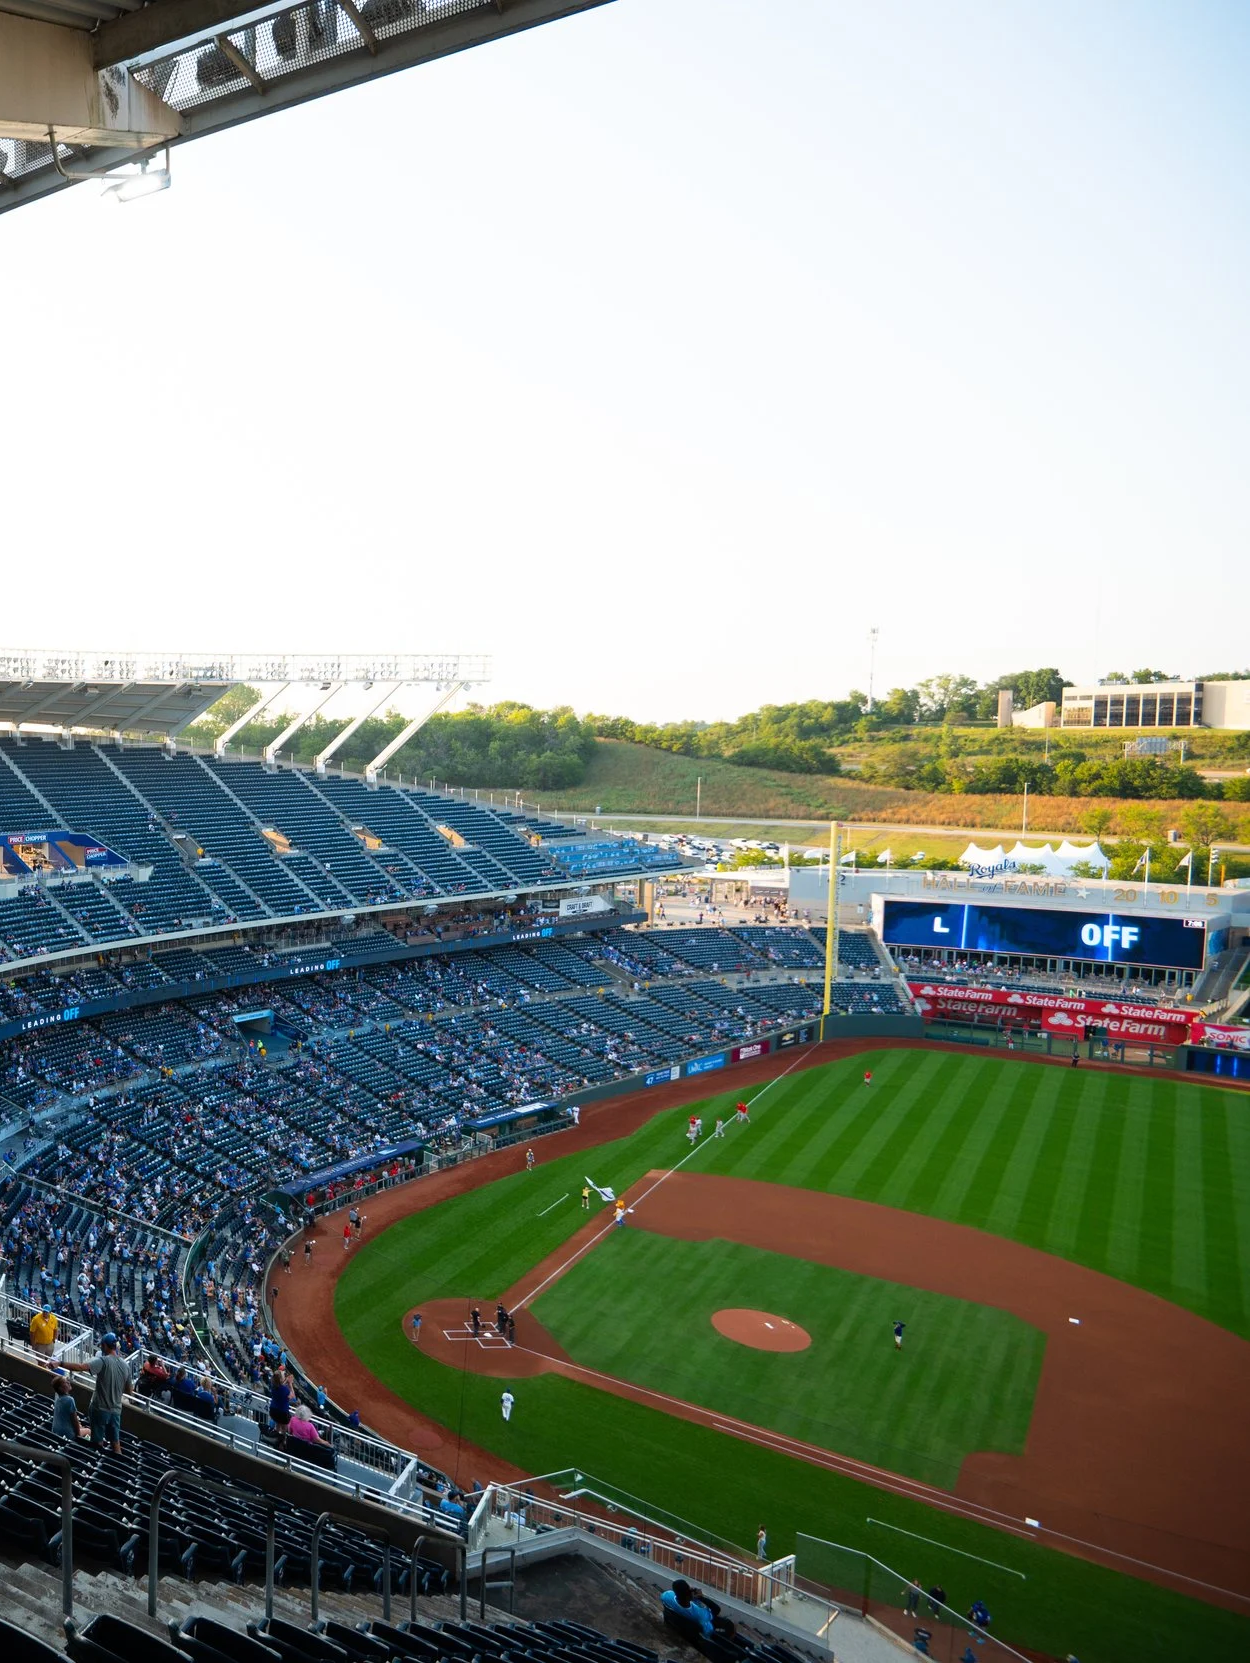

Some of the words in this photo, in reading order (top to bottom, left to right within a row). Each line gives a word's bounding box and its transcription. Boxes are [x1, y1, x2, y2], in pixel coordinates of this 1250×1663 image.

[968, 858, 1017, 880] Royals
[922, 874, 975, 893] HALL
[1003, 879, 1067, 897] FAME
[582, 901, 593, 909] DRAFT
[1113, 888, 1138, 903] 20
[1158, 890, 1180, 905] 10
[1204, 892, 1219, 907] 5
[933, 916, 950, 933] L
[513, 931, 540, 940] LEADING
[542, 928, 552, 937] OFF
[1081, 923, 1140, 949] OFF
[290, 963, 325, 975] LEADING
[326, 959, 340, 970] OFF
[22, 1014, 61, 1030] LEADING
[63, 1007, 79, 1020] OFF
[1208, 1031, 1247, 1044] SONIC
